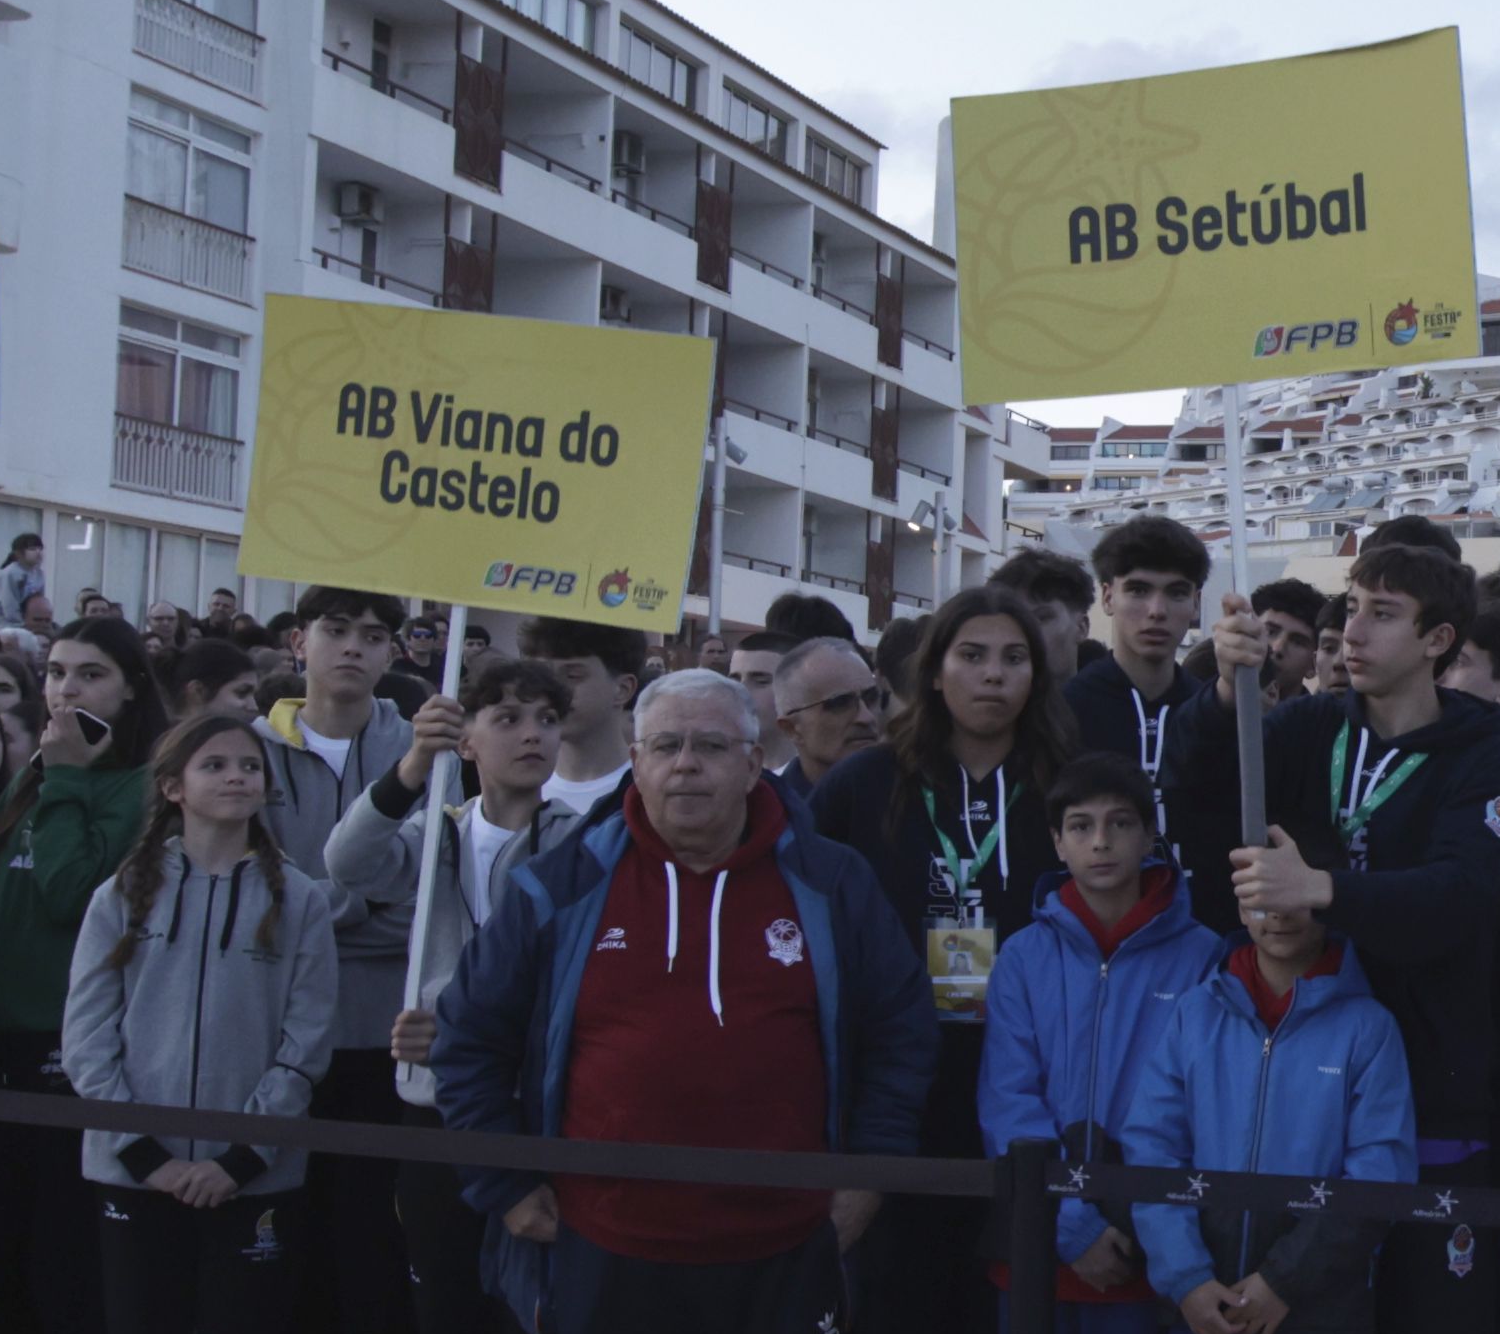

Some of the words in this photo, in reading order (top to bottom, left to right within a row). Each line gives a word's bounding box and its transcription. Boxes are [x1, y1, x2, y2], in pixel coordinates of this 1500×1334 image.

[1068, 203, 1139, 264] AB
[1155, 171, 1367, 256] Setúbal
[1283, 320, 1359, 352] FPB
[336, 382, 397, 439] AB
[410, 390, 545, 458] Viana
[559, 410, 619, 467] do
[379, 450, 560, 523] Castelo
[510, 566, 577, 595] FPB
